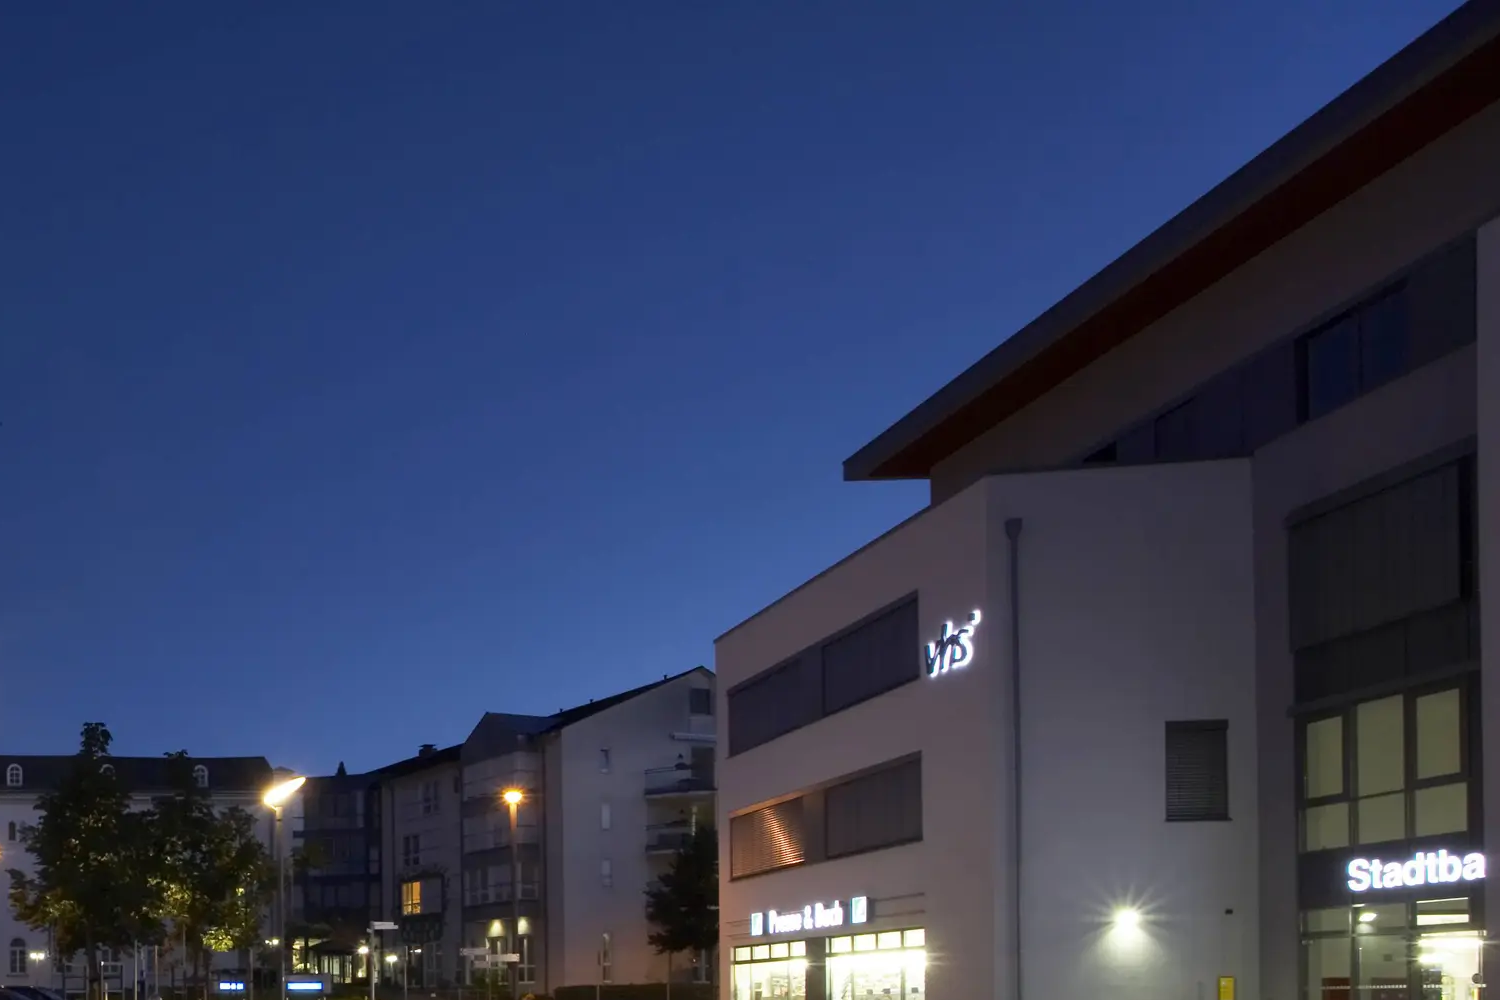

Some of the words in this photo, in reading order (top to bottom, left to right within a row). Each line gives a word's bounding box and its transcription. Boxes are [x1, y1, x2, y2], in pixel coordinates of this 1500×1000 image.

[923, 609, 981, 679] vhs
[1346, 849, 1487, 892] Stadtba
[803, 904, 814, 930] &
[814, 899, 844, 929] Buch
